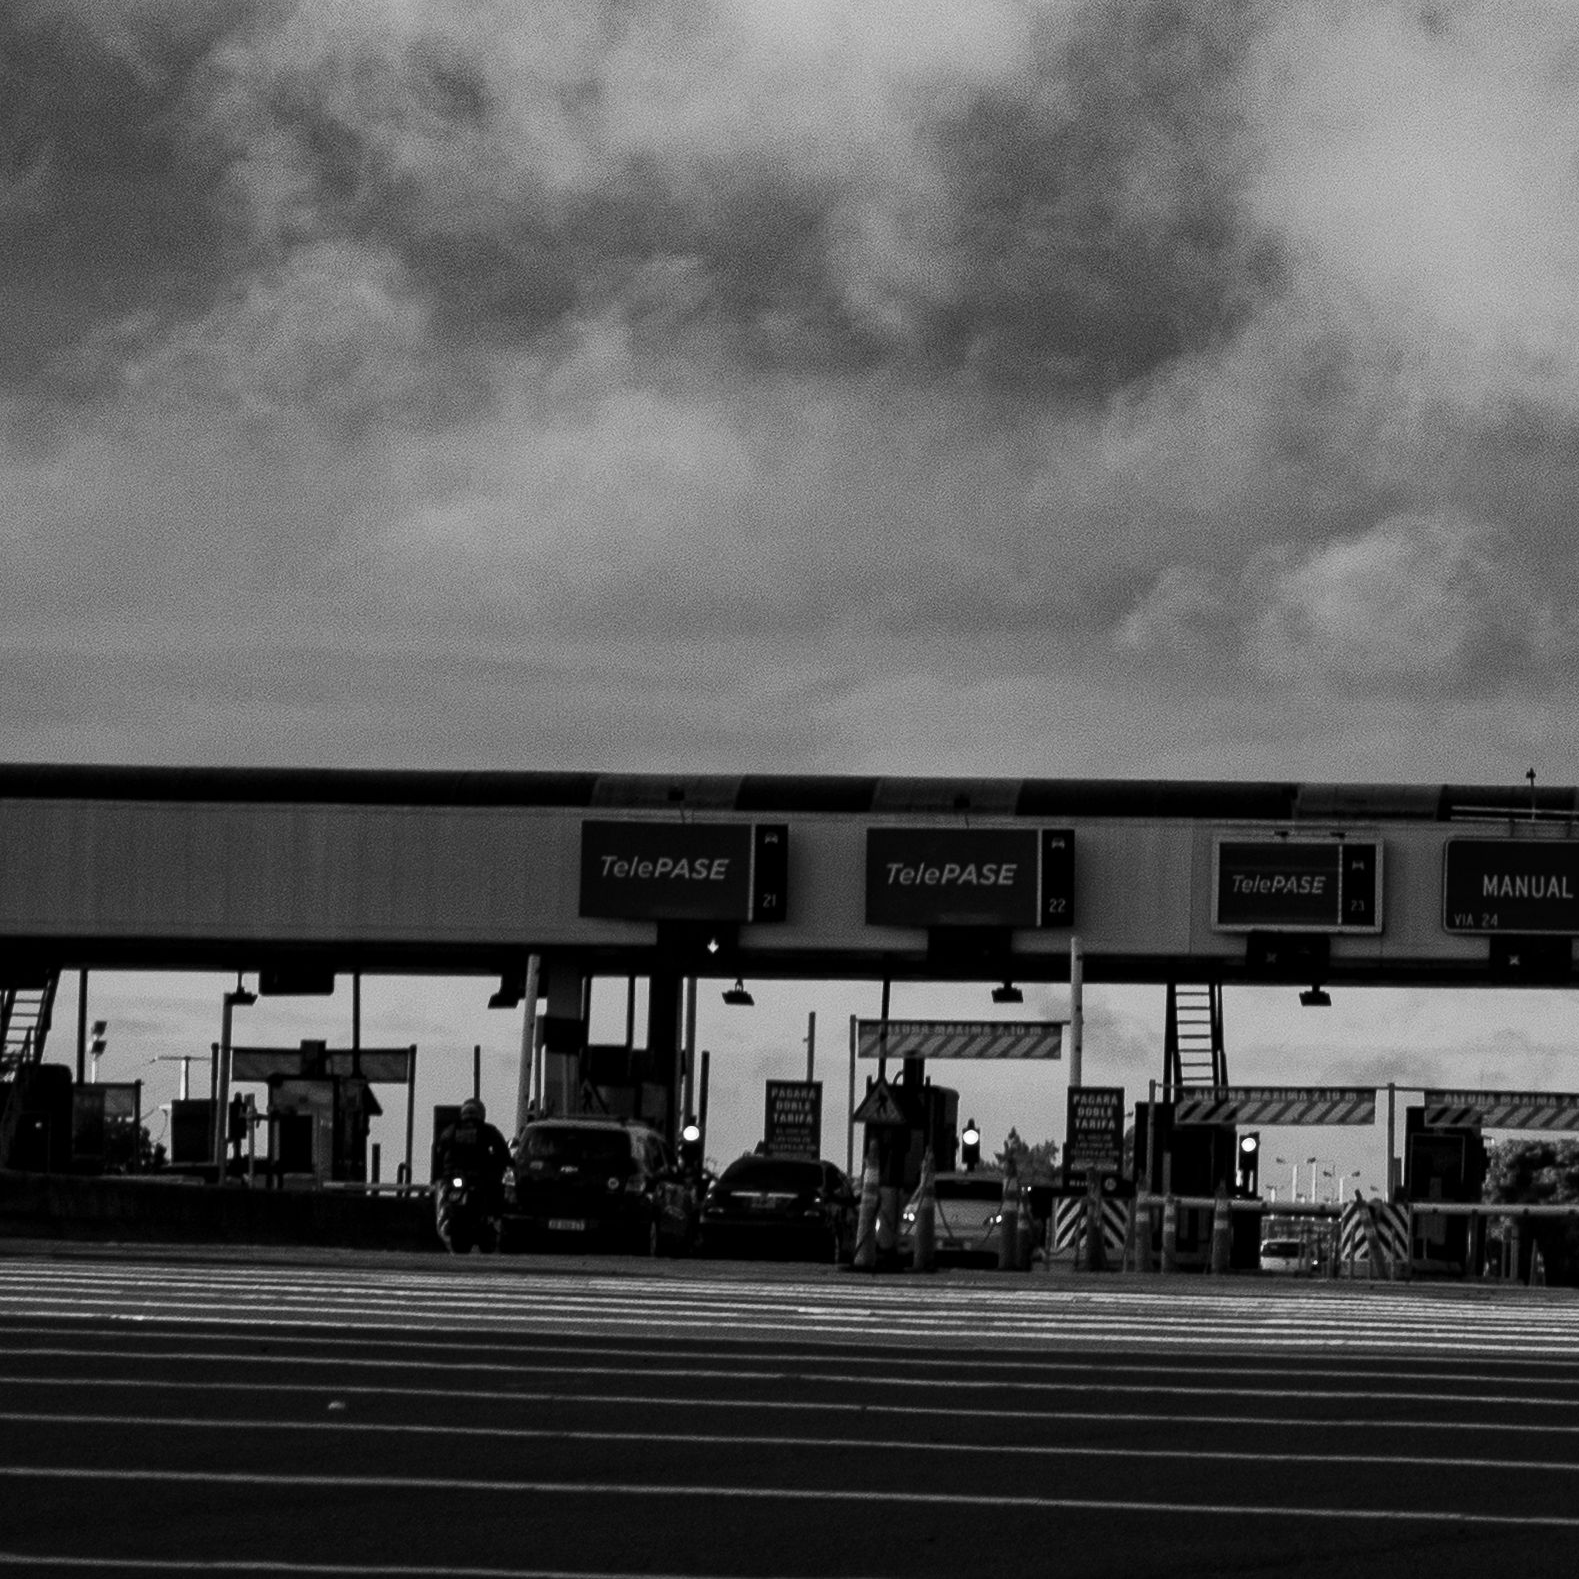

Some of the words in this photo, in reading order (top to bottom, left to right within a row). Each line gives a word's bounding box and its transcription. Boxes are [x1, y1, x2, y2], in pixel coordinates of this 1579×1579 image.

[600, 855, 730, 880] TelePASE
[886, 863, 1018, 886] TelePASE
[1232, 874, 1327, 895] TelePASE
[1482, 874, 1575, 900] MANUAL
[763, 893, 777, 908] 21
[1049, 898, 1067, 913] 22
[1454, 913, 1474, 928] VIA
[1482, 913, 1499, 928] 24
